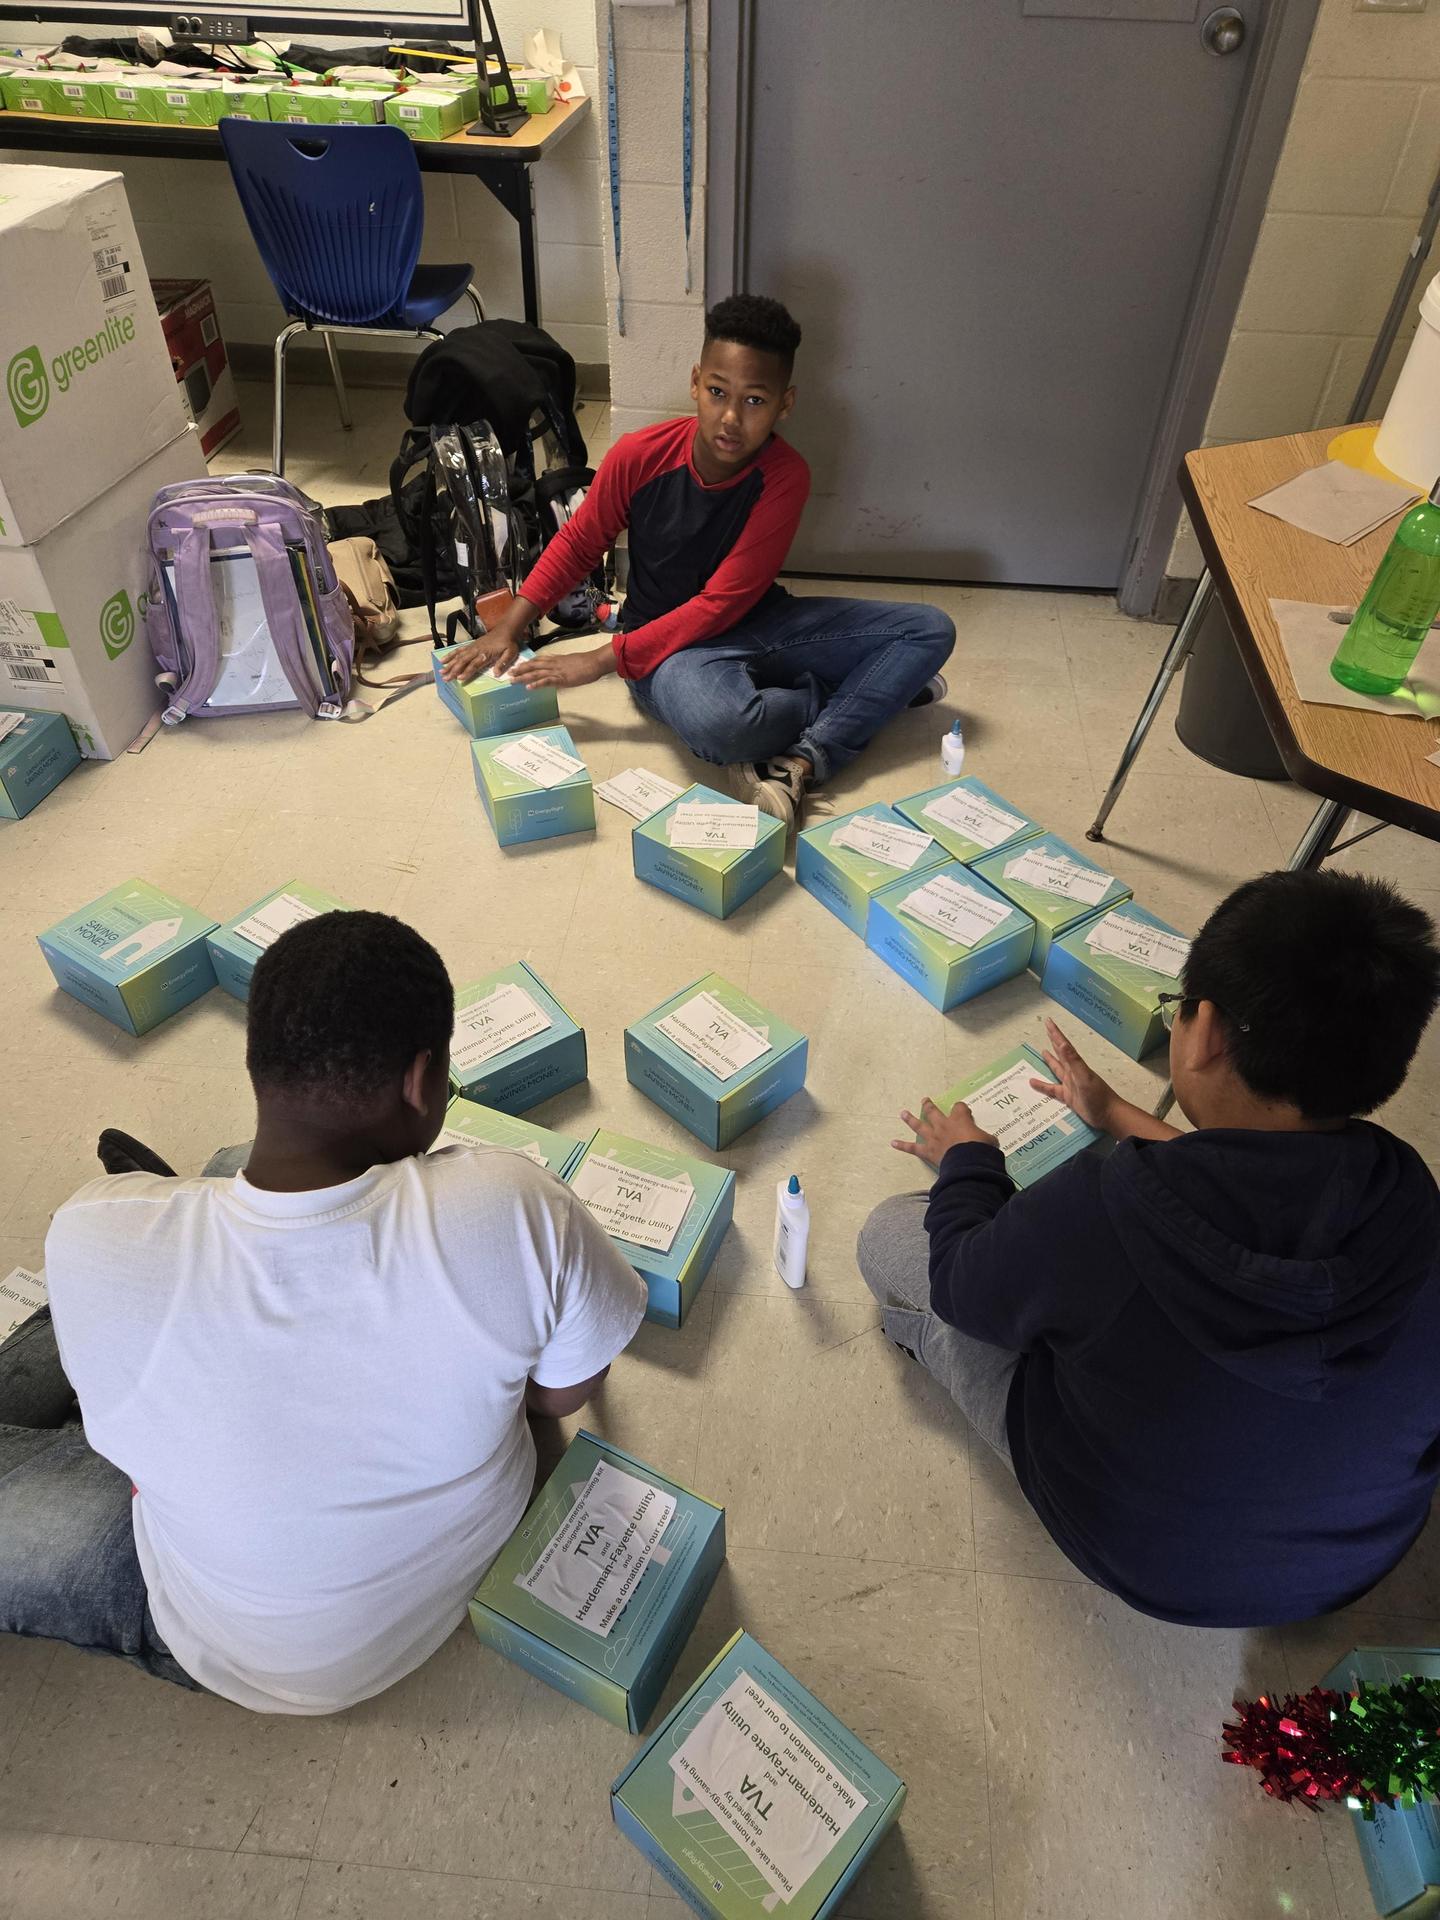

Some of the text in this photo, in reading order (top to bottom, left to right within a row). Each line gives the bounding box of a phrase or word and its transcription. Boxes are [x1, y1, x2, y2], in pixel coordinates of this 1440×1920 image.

[52, 314, 136, 393] greenlite
[868, 841, 892, 850] TVA
[936, 908, 960, 921] TVA
[75, 924, 108, 950] MONEY.
[87, 918, 118, 942] SAVING
[1124, 928, 1191, 957] ardeman-Fayette
[1125, 943, 1153, 955] TVA
[468, 1014, 492, 1030] TVA
[709, 1020, 730, 1041] TVA
[994, 1092, 1017, 1110] TVA
[993, 1103, 1044, 1138] ardeman-Fayette
[1015, 1129, 1056, 1157] MONEY.
[613, 1186, 645, 1200] TVA
[580, 1198, 672, 1231] rdeman-Fayette Utility
[644, 1236, 660, 1244] tree!
[527, 1563, 544, 1588] Please
[543, 1548, 554, 1564] take
[556, 1522, 569, 1542] home
[568, 1476, 598, 1523] energy-saving
[561, 1511, 588, 1551] designed by
[575, 1519, 602, 1558] TVA
[575, 1520, 637, 1620] Hardeman-Fayette
[633, 1489, 655, 1520] Utility
[600, 1540, 610, 1554] and
[622, 1552, 632, 1566] and
[599, 1505, 671, 1628] Make a donation to our tree!
[721, 1700, 752, 1734] Utility
[745, 1686, 855, 1807] Make a donation to our tree!
[783, 1748, 797, 1763] and
[678, 1757, 689, 1769] kit
[750, 1732, 841, 1835] Hardeman-Fayette
[763, 1771, 777, 1786] and
[687, 1767, 733, 1819] energy-saving
[736, 1776, 776, 1818] TVA
[723, 1791, 763, 1835] designed by
[730, 1819, 750, 1841] home
[682, 1848, 714, 1884] EnergyRight
[754, 1846, 770, 1864] take
[768, 1863, 793, 1891] Please
